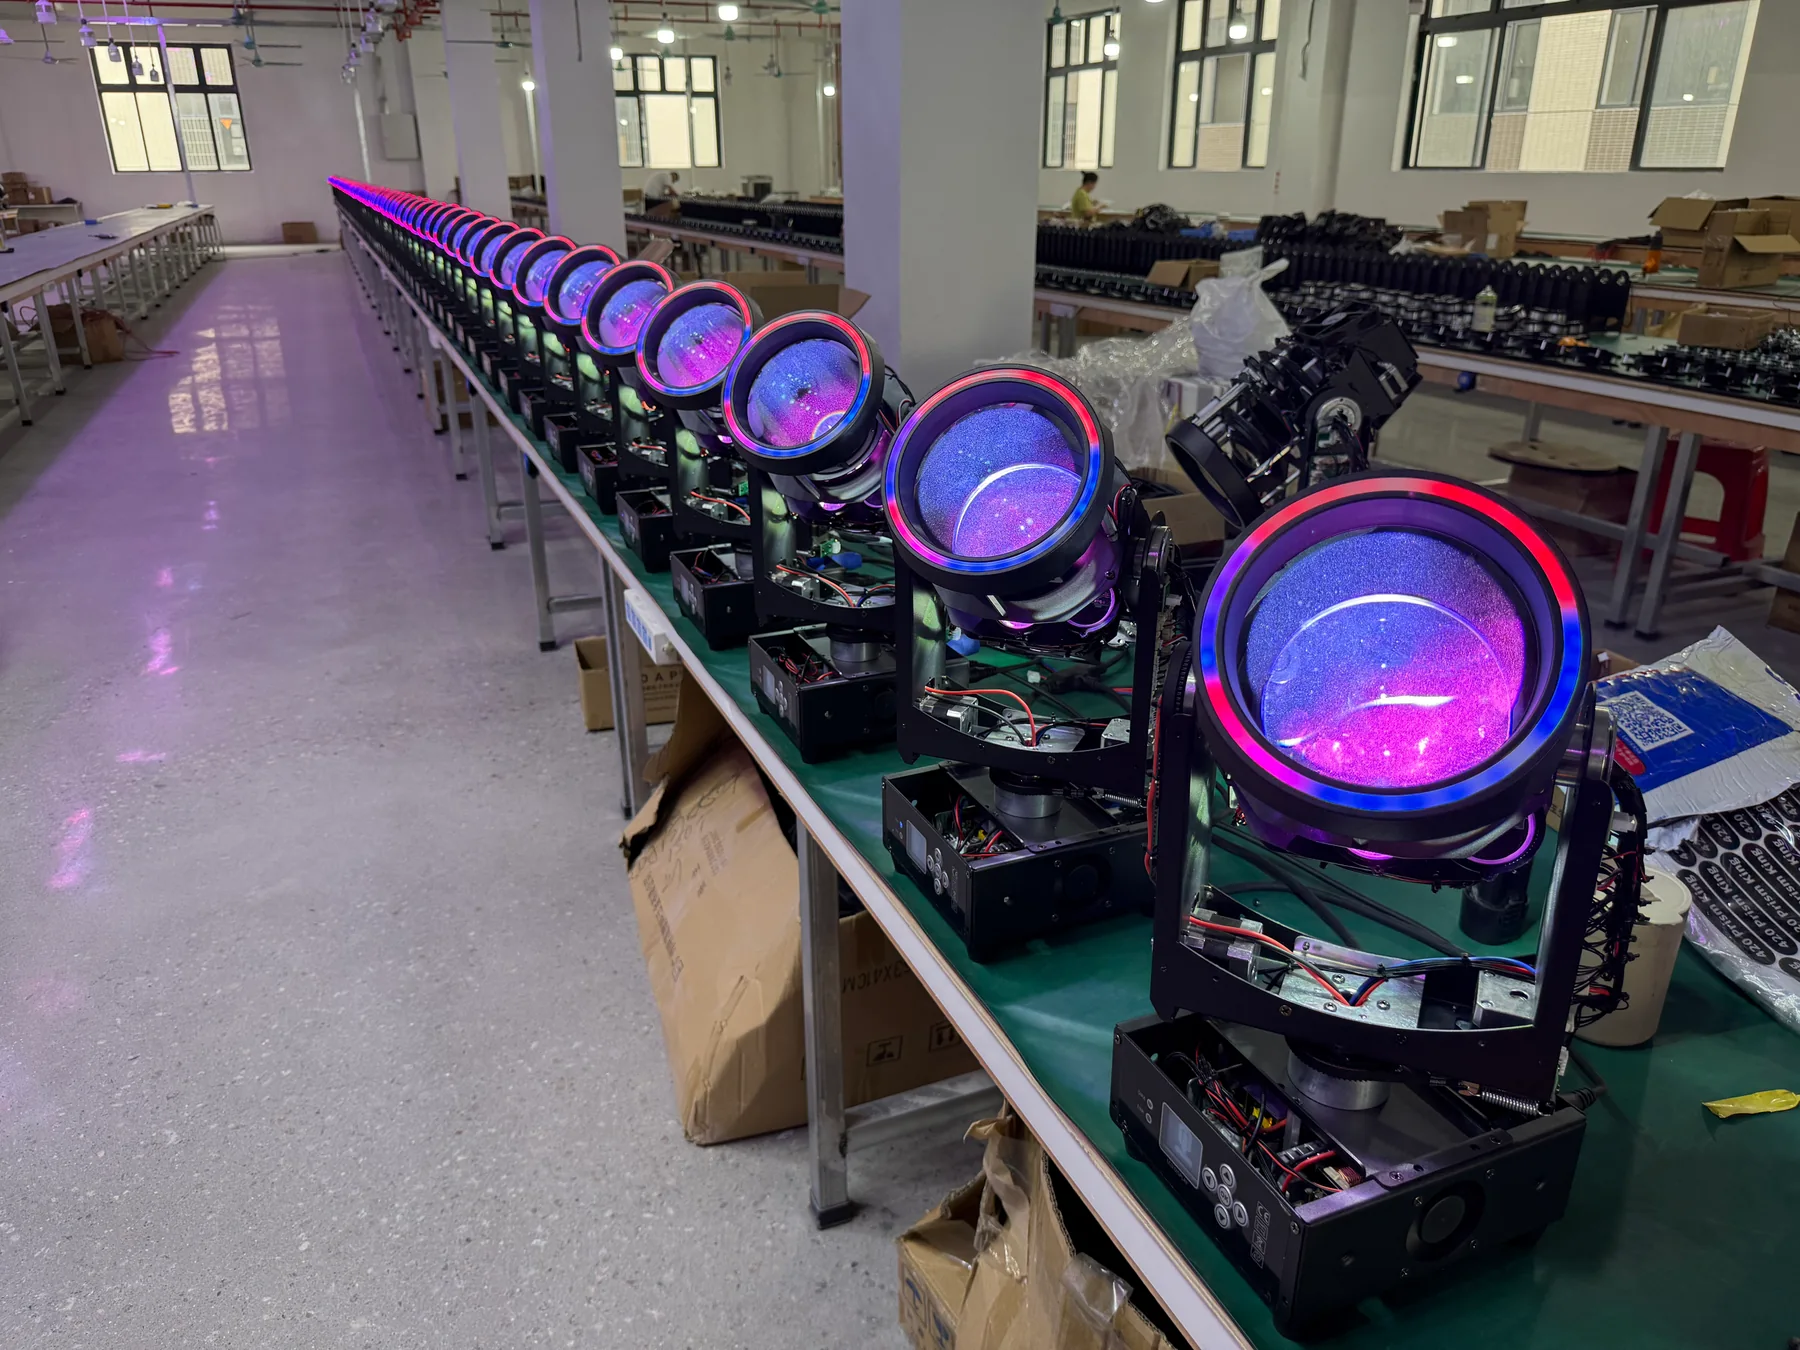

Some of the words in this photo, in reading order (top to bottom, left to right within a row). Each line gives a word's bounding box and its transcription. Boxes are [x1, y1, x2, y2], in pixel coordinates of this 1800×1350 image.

[1711, 822, 1732, 843] 420
[1733, 814, 1754, 834] 420
[1729, 856, 1756, 884] King
[1750, 848, 1778, 875] King
[1685, 874, 1711, 903] King
[1707, 865, 1733, 894] King
[1776, 875, 1800, 904] rism
[1731, 894, 1767, 928] Prism
[1754, 885, 1789, 918] Prism
[1709, 903, 1744, 938] Prism
[1741, 938, 1767, 958] 420
[1764, 928, 1789, 948] 420
